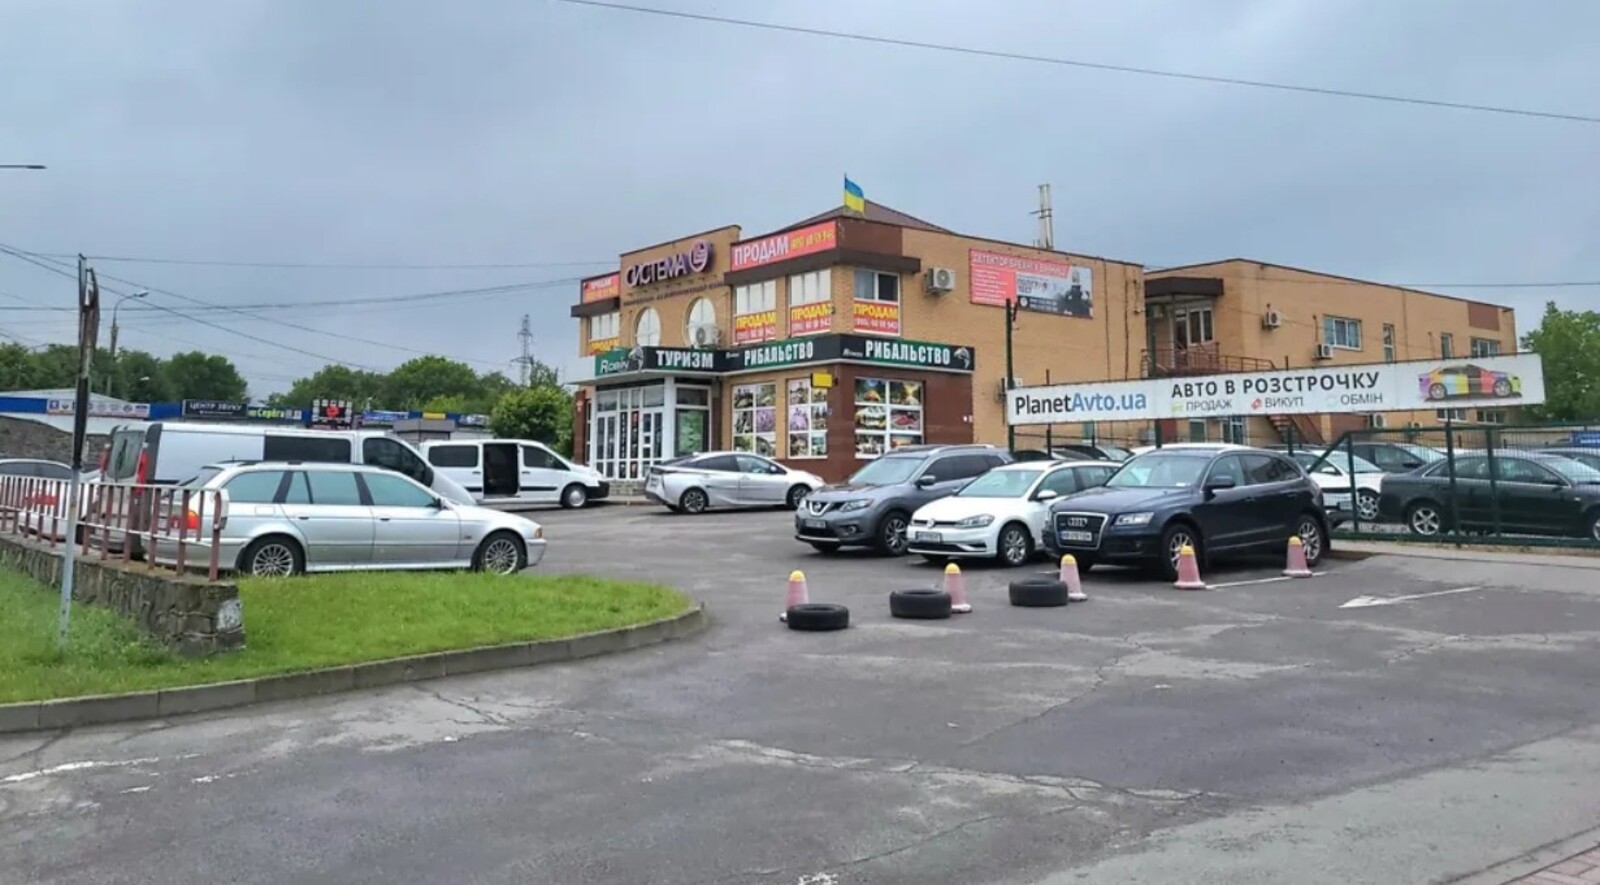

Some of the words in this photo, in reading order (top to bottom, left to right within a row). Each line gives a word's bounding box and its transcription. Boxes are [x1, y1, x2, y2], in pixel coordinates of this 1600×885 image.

[734, 236, 788, 267] ПРОДАМ
[625, 253, 687, 287] СИСТЕМА
[736, 311, 776, 329] ПРОДАМ
[791, 303, 831, 322] ПРОДАМ
[853, 303, 898, 319] ПРОДАМ
[655, 350, 714, 369] ТУРИЗМ
[744, 341, 814, 367] РИБАЛЬСТВО
[865, 340, 951, 365] РИБАЛЬСТВО
[1171, 380, 1218, 399] АВТО
[1225, 379, 1236, 394] В
[1243, 371, 1380, 394] РОЗСТРОЧКУ
[1015, 392, 1147, 415] PlanetAvto.ua
[1186, 398, 1233, 412] ПРОДАЖ
[1265, 396, 1304, 408] ВИКУП
[1340, 392, 1384, 405] ОБМІН
